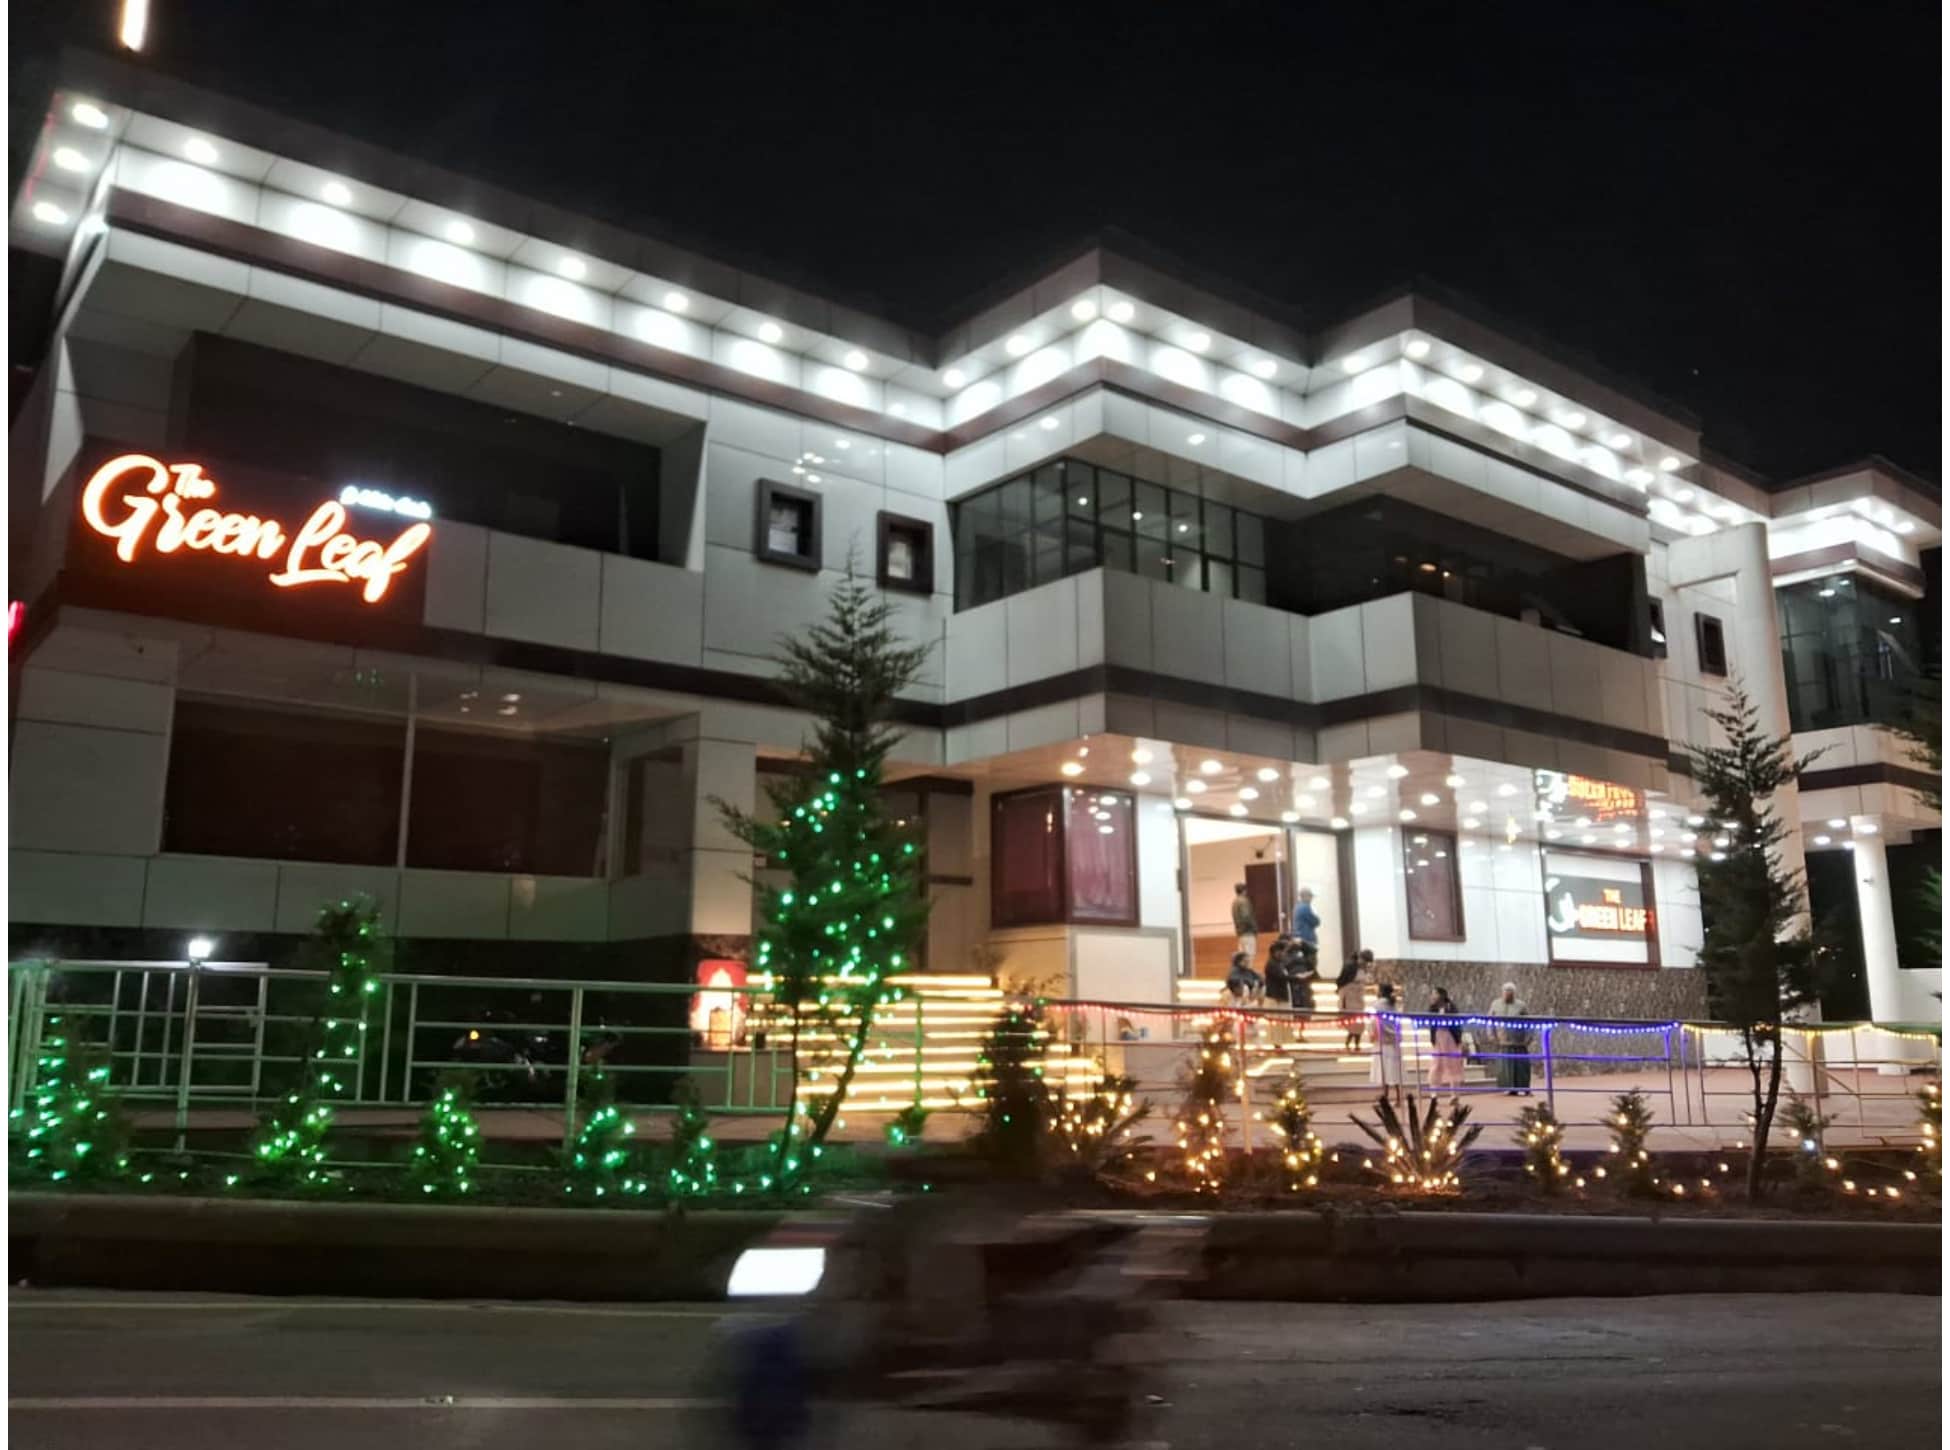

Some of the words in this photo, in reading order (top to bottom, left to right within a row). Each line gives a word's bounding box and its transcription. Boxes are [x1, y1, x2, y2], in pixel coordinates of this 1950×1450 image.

[169, 463, 216, 499] The
[82, 454, 286, 562] Green
[269, 500, 431, 602] Leaf
[1619, 906, 1647, 931] LEAF
